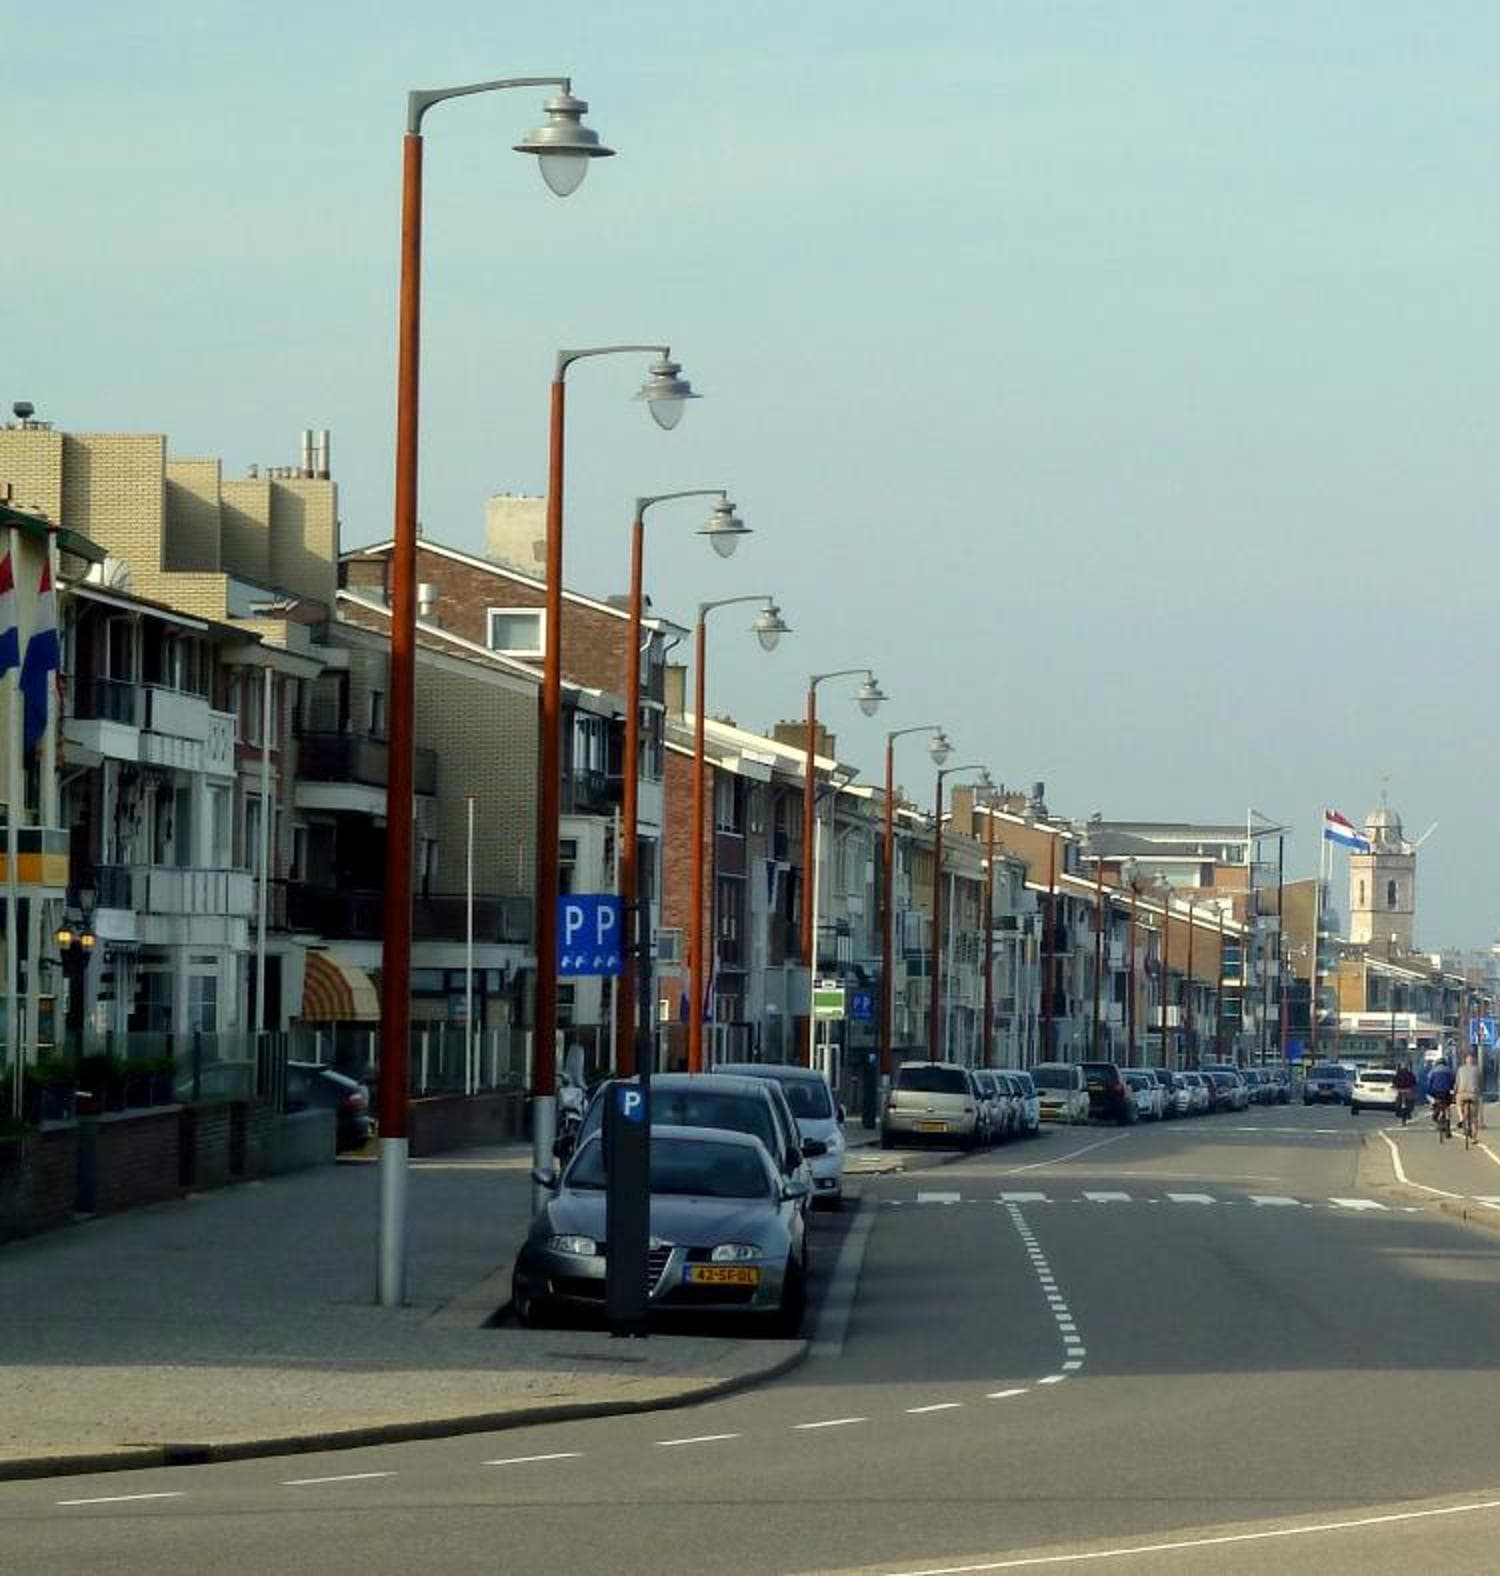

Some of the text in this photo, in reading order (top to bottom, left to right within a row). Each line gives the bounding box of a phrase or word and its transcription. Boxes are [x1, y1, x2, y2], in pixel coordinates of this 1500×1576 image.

[565, 905, 615, 945] P P
[624, 1091, 641, 1116] P
